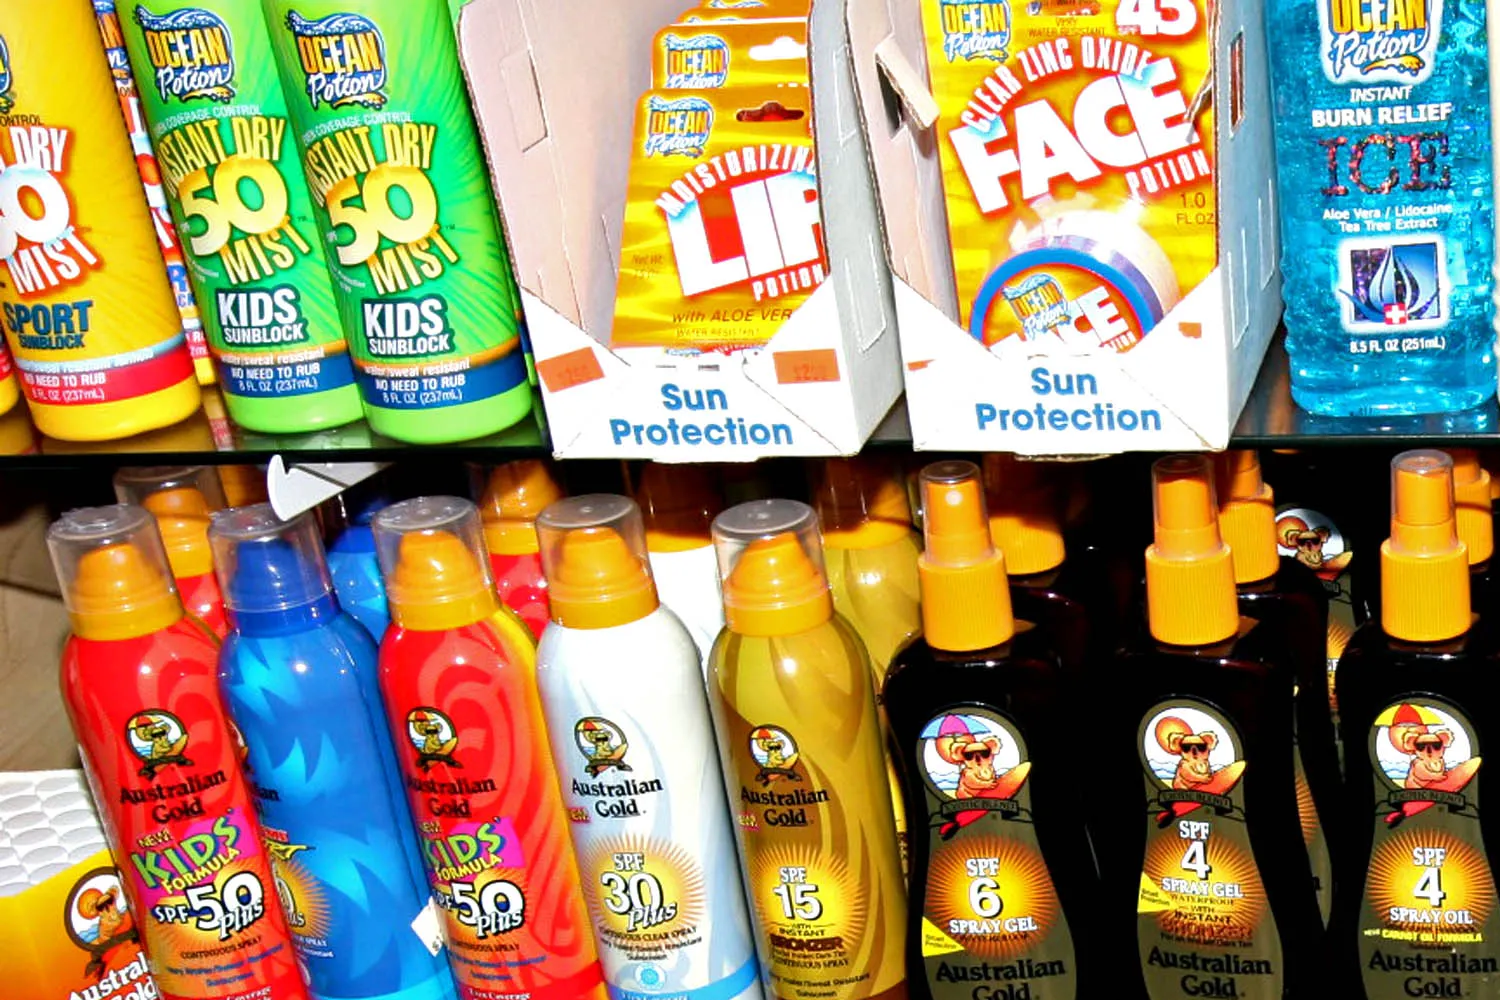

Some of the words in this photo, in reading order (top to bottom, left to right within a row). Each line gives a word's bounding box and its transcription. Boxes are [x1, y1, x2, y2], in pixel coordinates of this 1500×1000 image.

[144, 26, 228, 70] OCEAN
[157, 62, 227, 99] Potion
[961, 65, 1022, 132] CLEAR
[1016, 37, 1073, 82] ZINC
[1081, 37, 1150, 80] OXIDE
[1349, 86, 1413, 103] INSTANT
[1311, 107, 1372, 128] BURN
[1378, 103, 1453, 124] RELIEF
[10, 127, 68, 172] DRY
[948, 58, 1200, 214] FACE
[1125, 150, 1211, 198] POTION
[1317, 131, 1451, 196] ICE
[180, 155, 287, 259] 50
[1179, 192, 1206, 208] 1.0
[1323, 207, 1349, 220] Aloe
[1354, 207, 1381, 219] Vera
[1395, 202, 1453, 216] Lidocaine
[328, 164, 437, 266] 50
[1176, 213, 1192, 225] FL
[1195, 212, 1214, 225] OZ
[1339, 221, 1361, 232] Tea
[1366, 220, 1391, 231] Tree
[1396, 217, 1437, 230] Extract
[6, 231, 98, 294] MIST
[220, 212, 311, 285] MIST
[751, 263, 826, 302] POTION
[5, 301, 93, 334] SPORT
[217, 289, 297, 327] KIDS
[364, 299, 444, 336] KIDS
[672, 309, 706, 323] with
[710, 309, 754, 322] ALOE
[18, 332, 85, 350] SUNBLOCK
[224, 322, 304, 346] SUNBLOCK
[1350, 340, 1367, 353] 8.5
[1369, 339, 1382, 352] FL
[1385, 339, 1399, 352] OZ
[1402, 337, 1446, 352] (251mL)
[246, 367, 273, 379] NEED
[277, 366, 292, 378] TO
[296, 362, 320, 376] RUB
[1030, 367, 1098, 395] Sun
[660, 383, 729, 410] Sun
[975, 403, 1161, 431] Protection
[609, 418, 794, 446] Protection
[118, 768, 228, 804] Australian
[571, 775, 664, 799] Australian
[152, 802, 206, 825] Gold
[595, 798, 640, 818] Gold
[161, 847, 240, 893] FORMULA
[613, 853, 644, 872] SPF
[965, 858, 1000, 877] SPF
[1412, 848, 1446, 867] SPF
[778, 866, 807, 883] SPF
[1412, 867, 1445, 907] 4
[154, 902, 188, 924] SPF
[186, 870, 265, 930] 50
[600, 872, 663, 916] 30
[772, 882, 823, 920] 15
[968, 877, 1002, 918] 6
[627, 895, 676, 932] Plus
[949, 919, 1002, 934] SPRAY
[1003, 918, 1037, 933] GEL
[1390, 909, 1441, 925] SPRAY
[1444, 910, 1474, 924] OIL
[935, 957, 1066, 983] Australian
